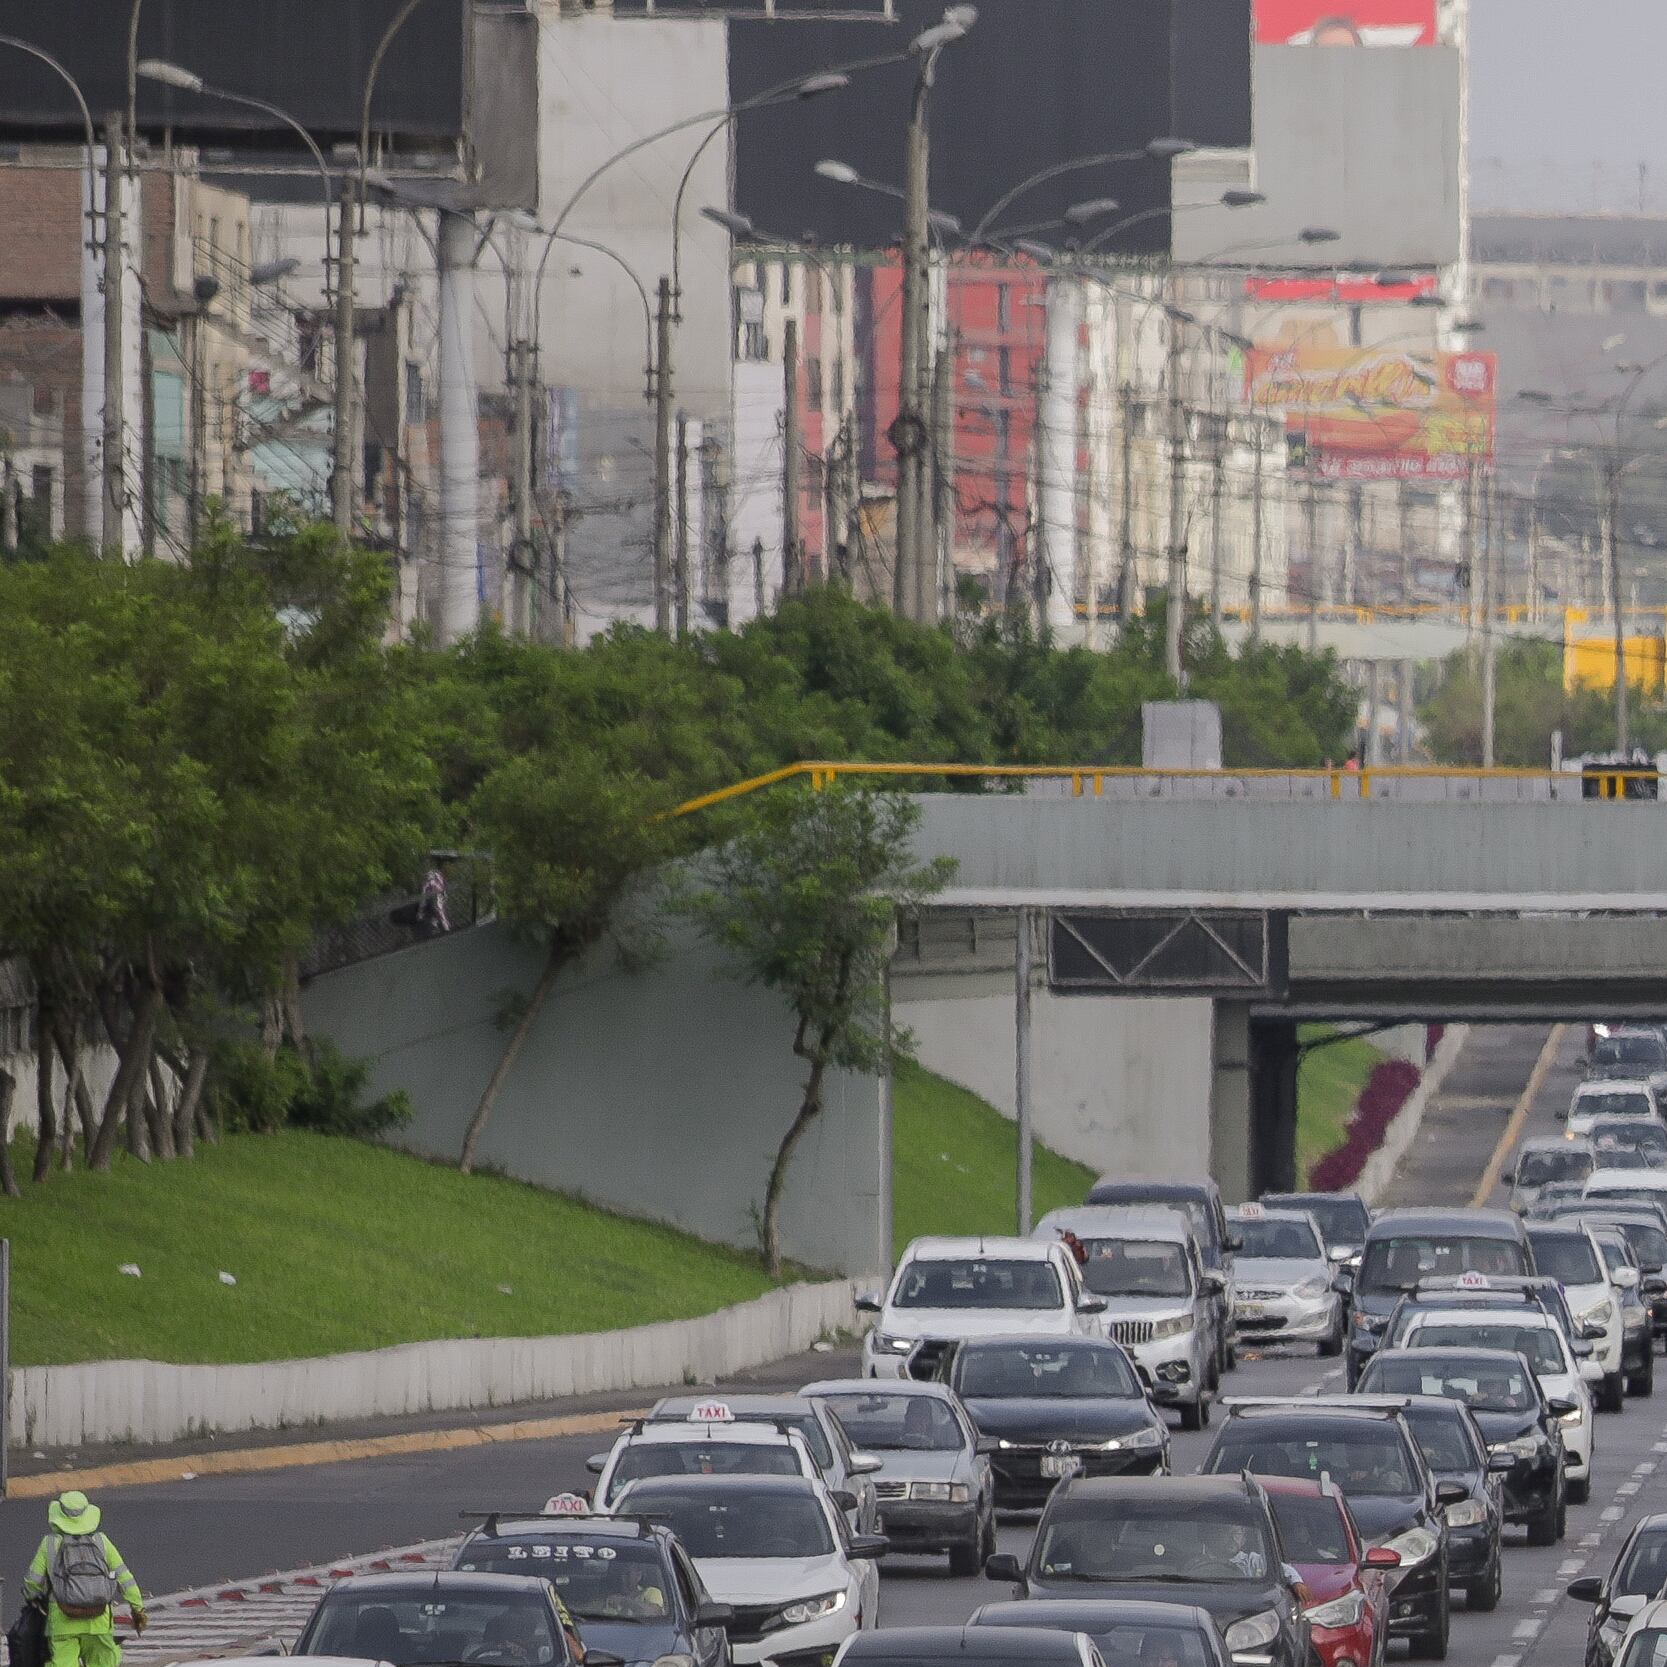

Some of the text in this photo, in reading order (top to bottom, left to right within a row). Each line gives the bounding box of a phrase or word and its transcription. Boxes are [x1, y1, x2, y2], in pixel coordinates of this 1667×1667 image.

[1462, 1276, 1483, 1287] TAXI
[697, 1406, 727, 1419] TAXI
[550, 1499, 584, 1512] TAXI
